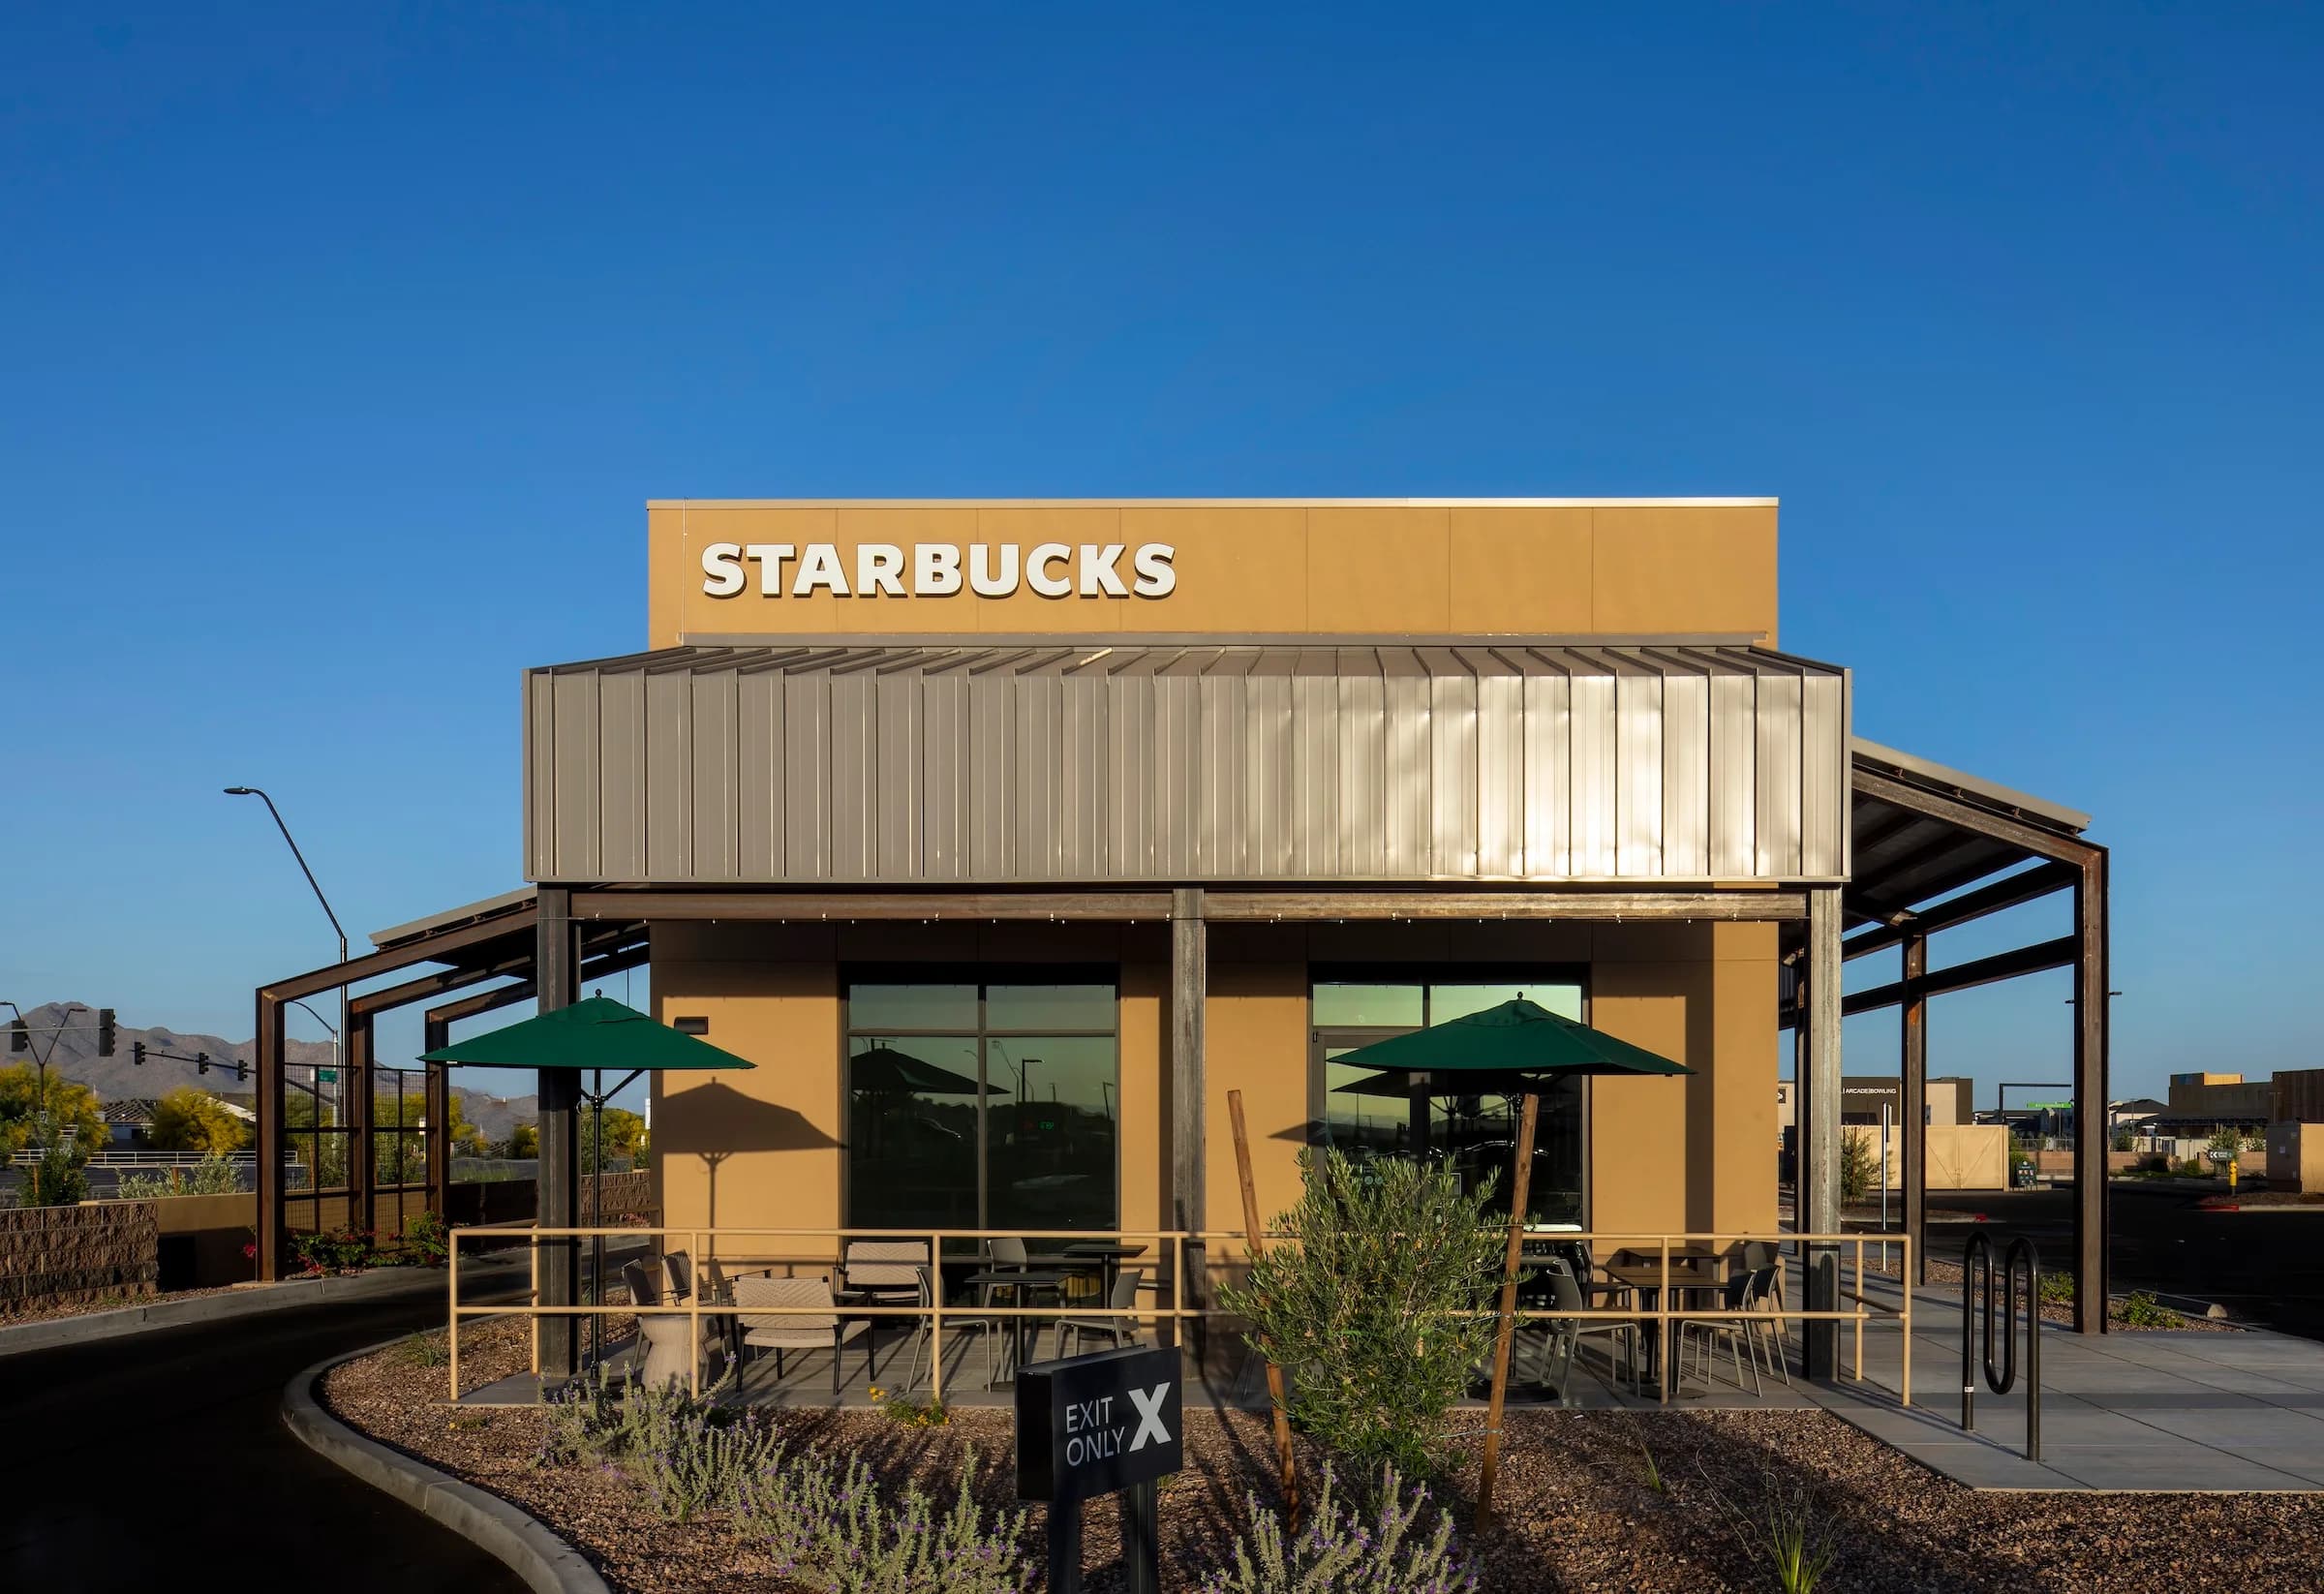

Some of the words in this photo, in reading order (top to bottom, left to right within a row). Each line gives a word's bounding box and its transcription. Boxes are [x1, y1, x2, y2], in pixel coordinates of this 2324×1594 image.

[700, 542, 1177, 598] STARBUCKS
[1066, 1396, 1113, 1433] EXIT
[1066, 1426, 1125, 1466] ONLY
